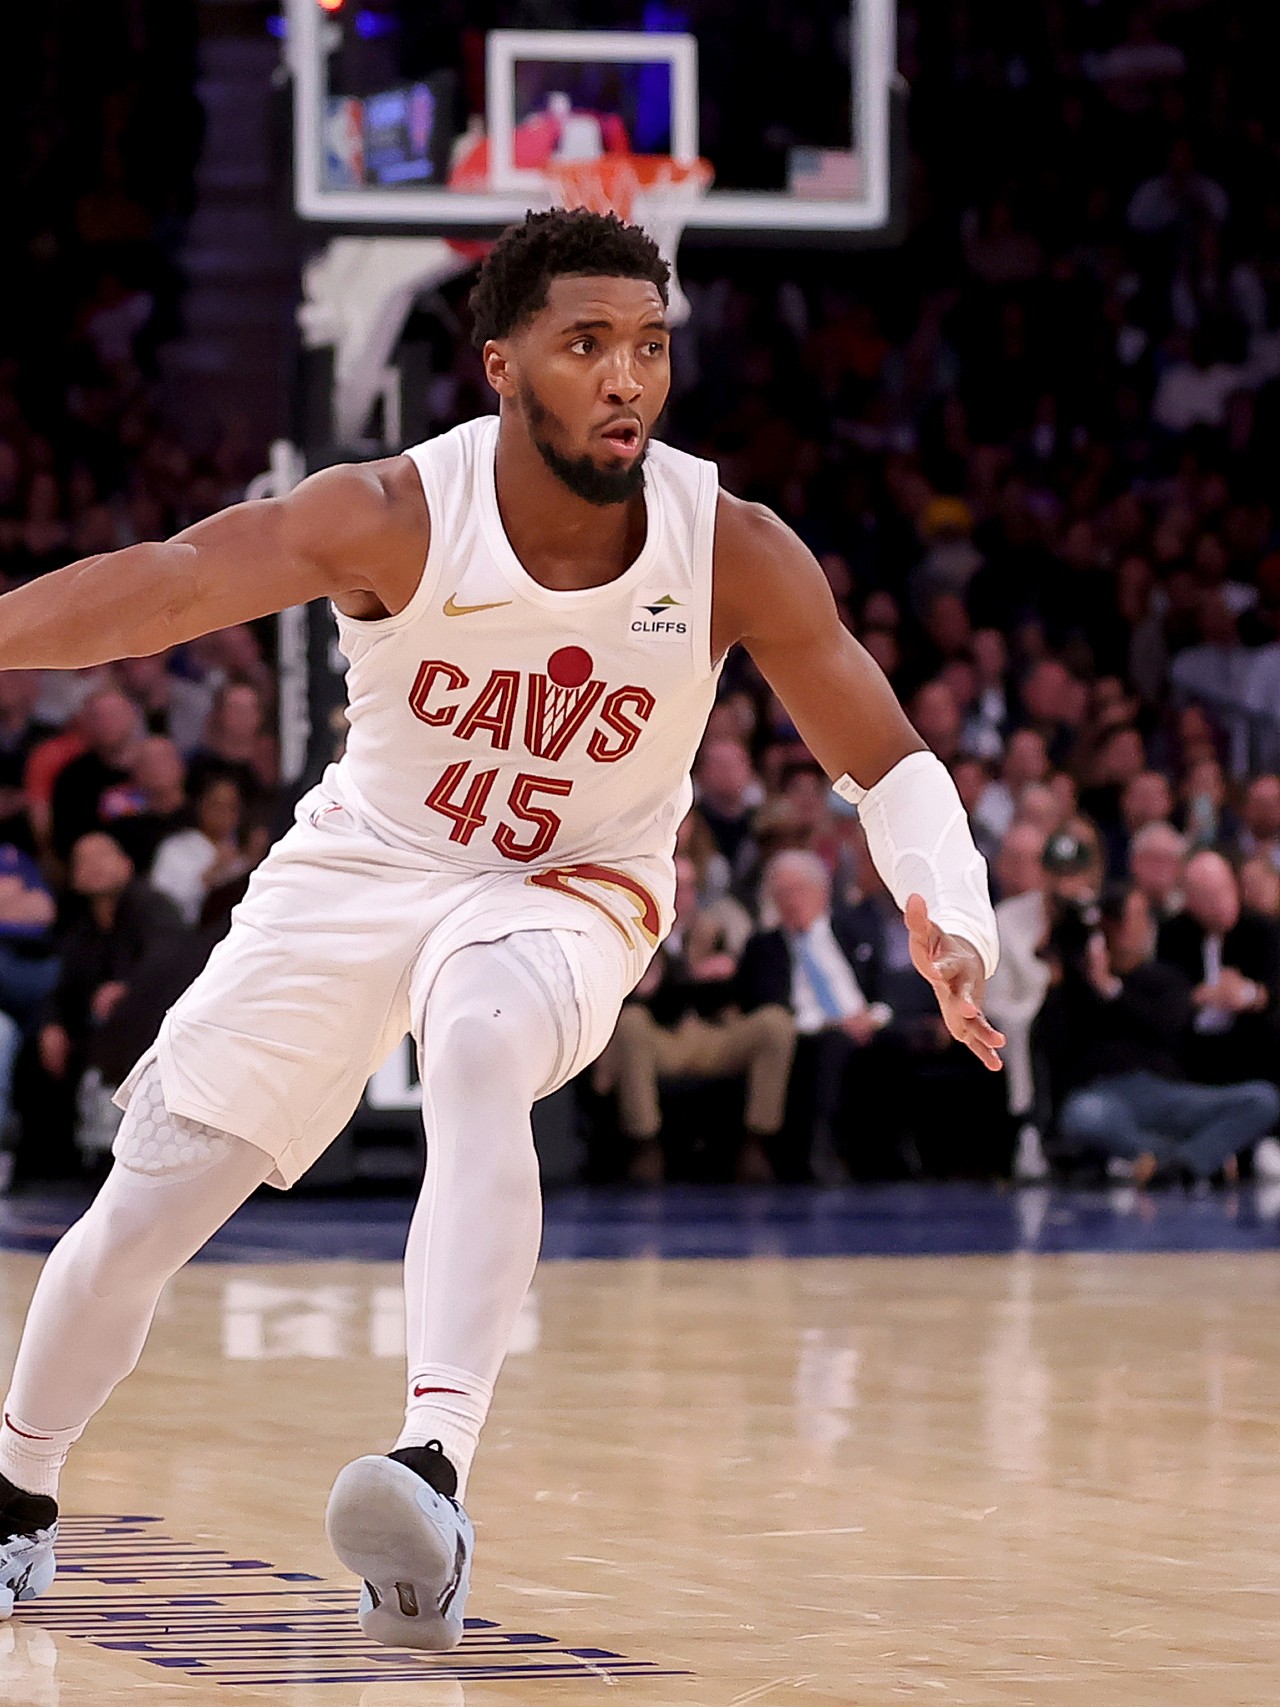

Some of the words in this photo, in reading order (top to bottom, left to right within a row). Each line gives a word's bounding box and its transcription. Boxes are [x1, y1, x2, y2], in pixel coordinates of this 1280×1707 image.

[631, 620, 688, 634] CLIFFS
[408, 658, 657, 764] CAVS
[423, 759, 574, 864] 45
